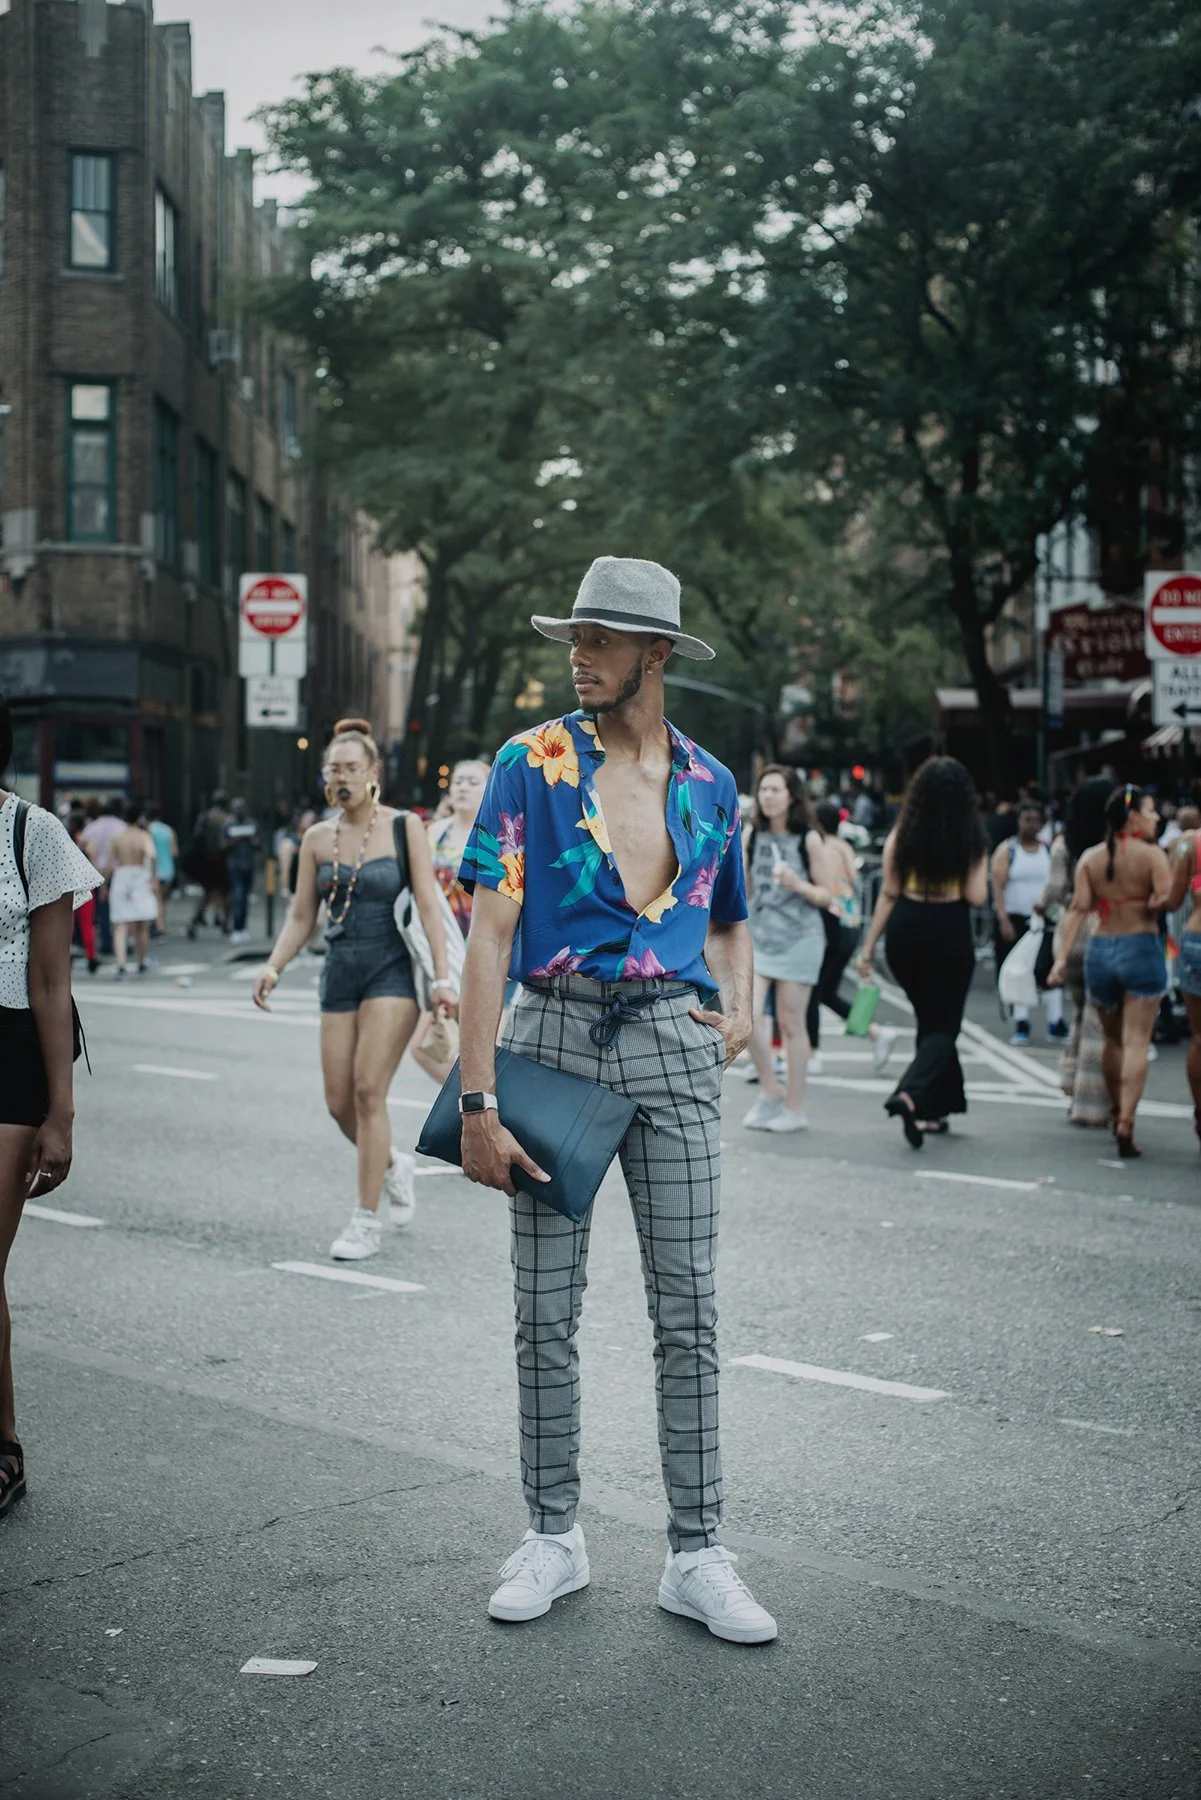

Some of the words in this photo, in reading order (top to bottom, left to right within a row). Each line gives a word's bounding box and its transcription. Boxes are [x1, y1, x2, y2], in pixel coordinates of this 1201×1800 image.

[1161, 589, 1180, 604] DO
[1184, 589, 1201, 604] NO
[1164, 627, 1201, 642] ENTE
[1170, 667, 1201, 678] ALL
[1161, 686, 1201, 697] TRAFF
